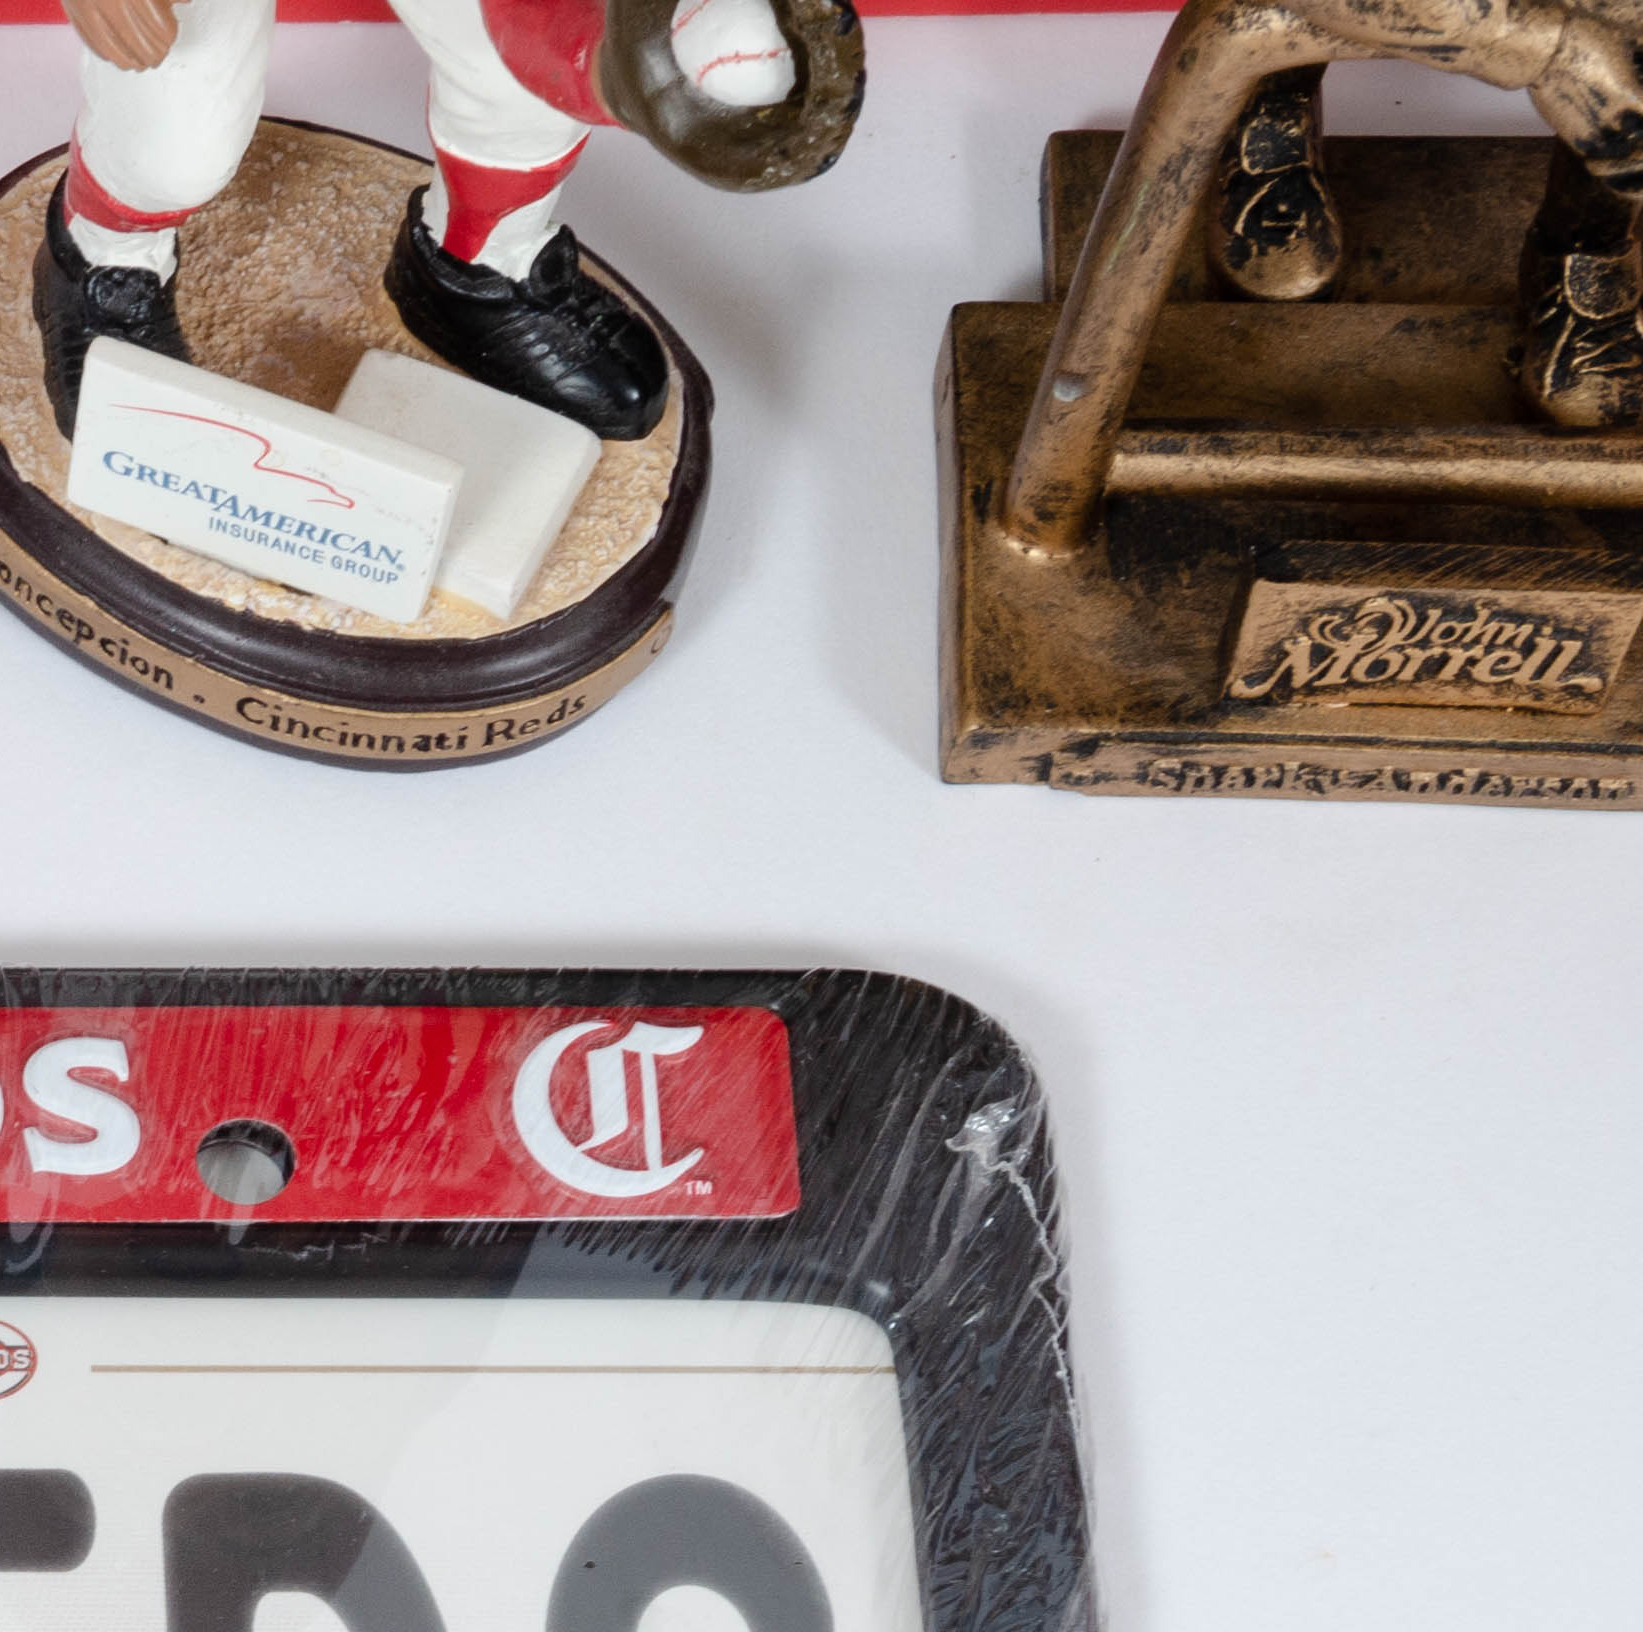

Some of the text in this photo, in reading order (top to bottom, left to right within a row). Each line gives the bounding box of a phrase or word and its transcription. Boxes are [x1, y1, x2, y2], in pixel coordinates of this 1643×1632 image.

[209, 516, 399, 586] INSURANCE GROUP
[1230, 634, 1604, 698] Morrell
[236, 696, 469, 753] Cincinnati
[482, 694, 586, 747] Reds
[684, 1181, 713, 1197] TM
